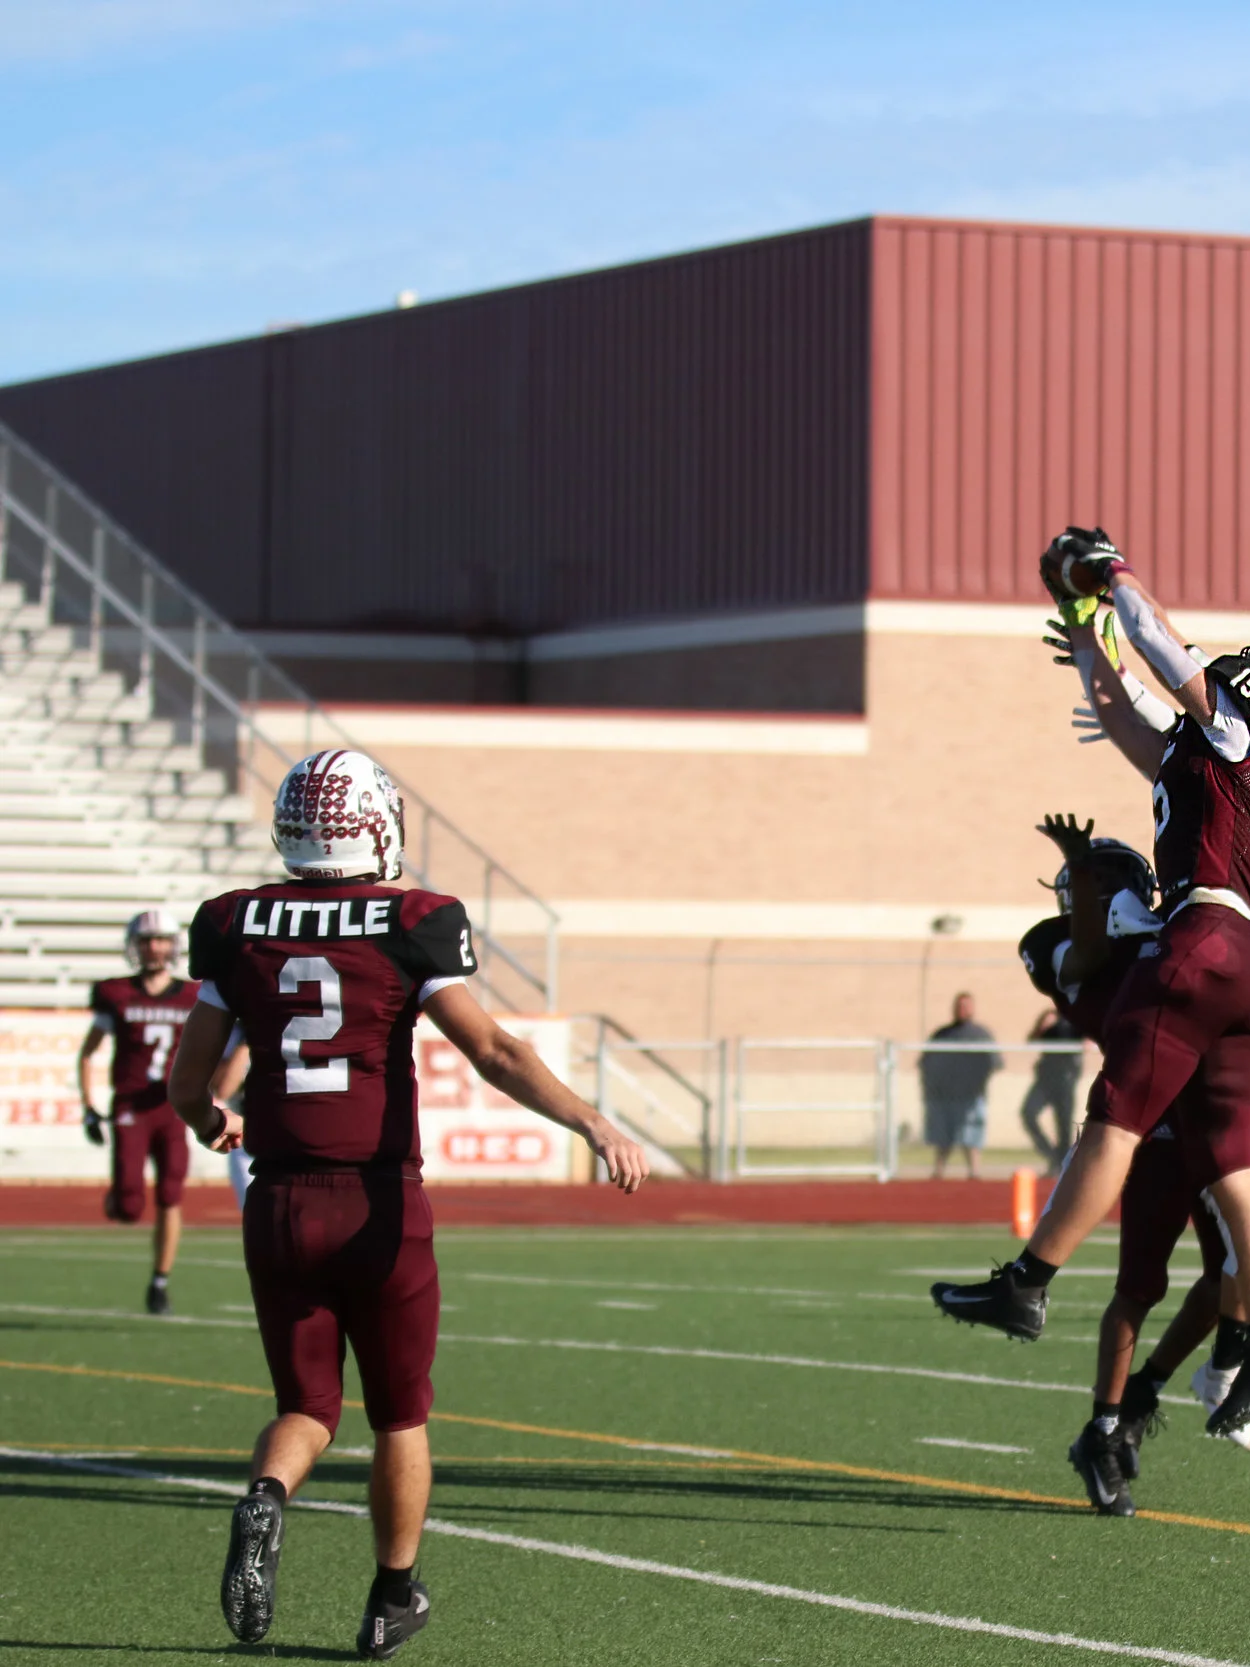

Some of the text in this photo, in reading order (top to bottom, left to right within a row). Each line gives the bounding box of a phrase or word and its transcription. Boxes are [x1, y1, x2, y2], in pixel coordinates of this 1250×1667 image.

[323, 844, 332, 855] 2
[242, 900, 391, 936] LITTLE
[459, 929, 473, 967] 2
[279, 956, 348, 1094] 2
[143, 1024, 174, 1081] 7
